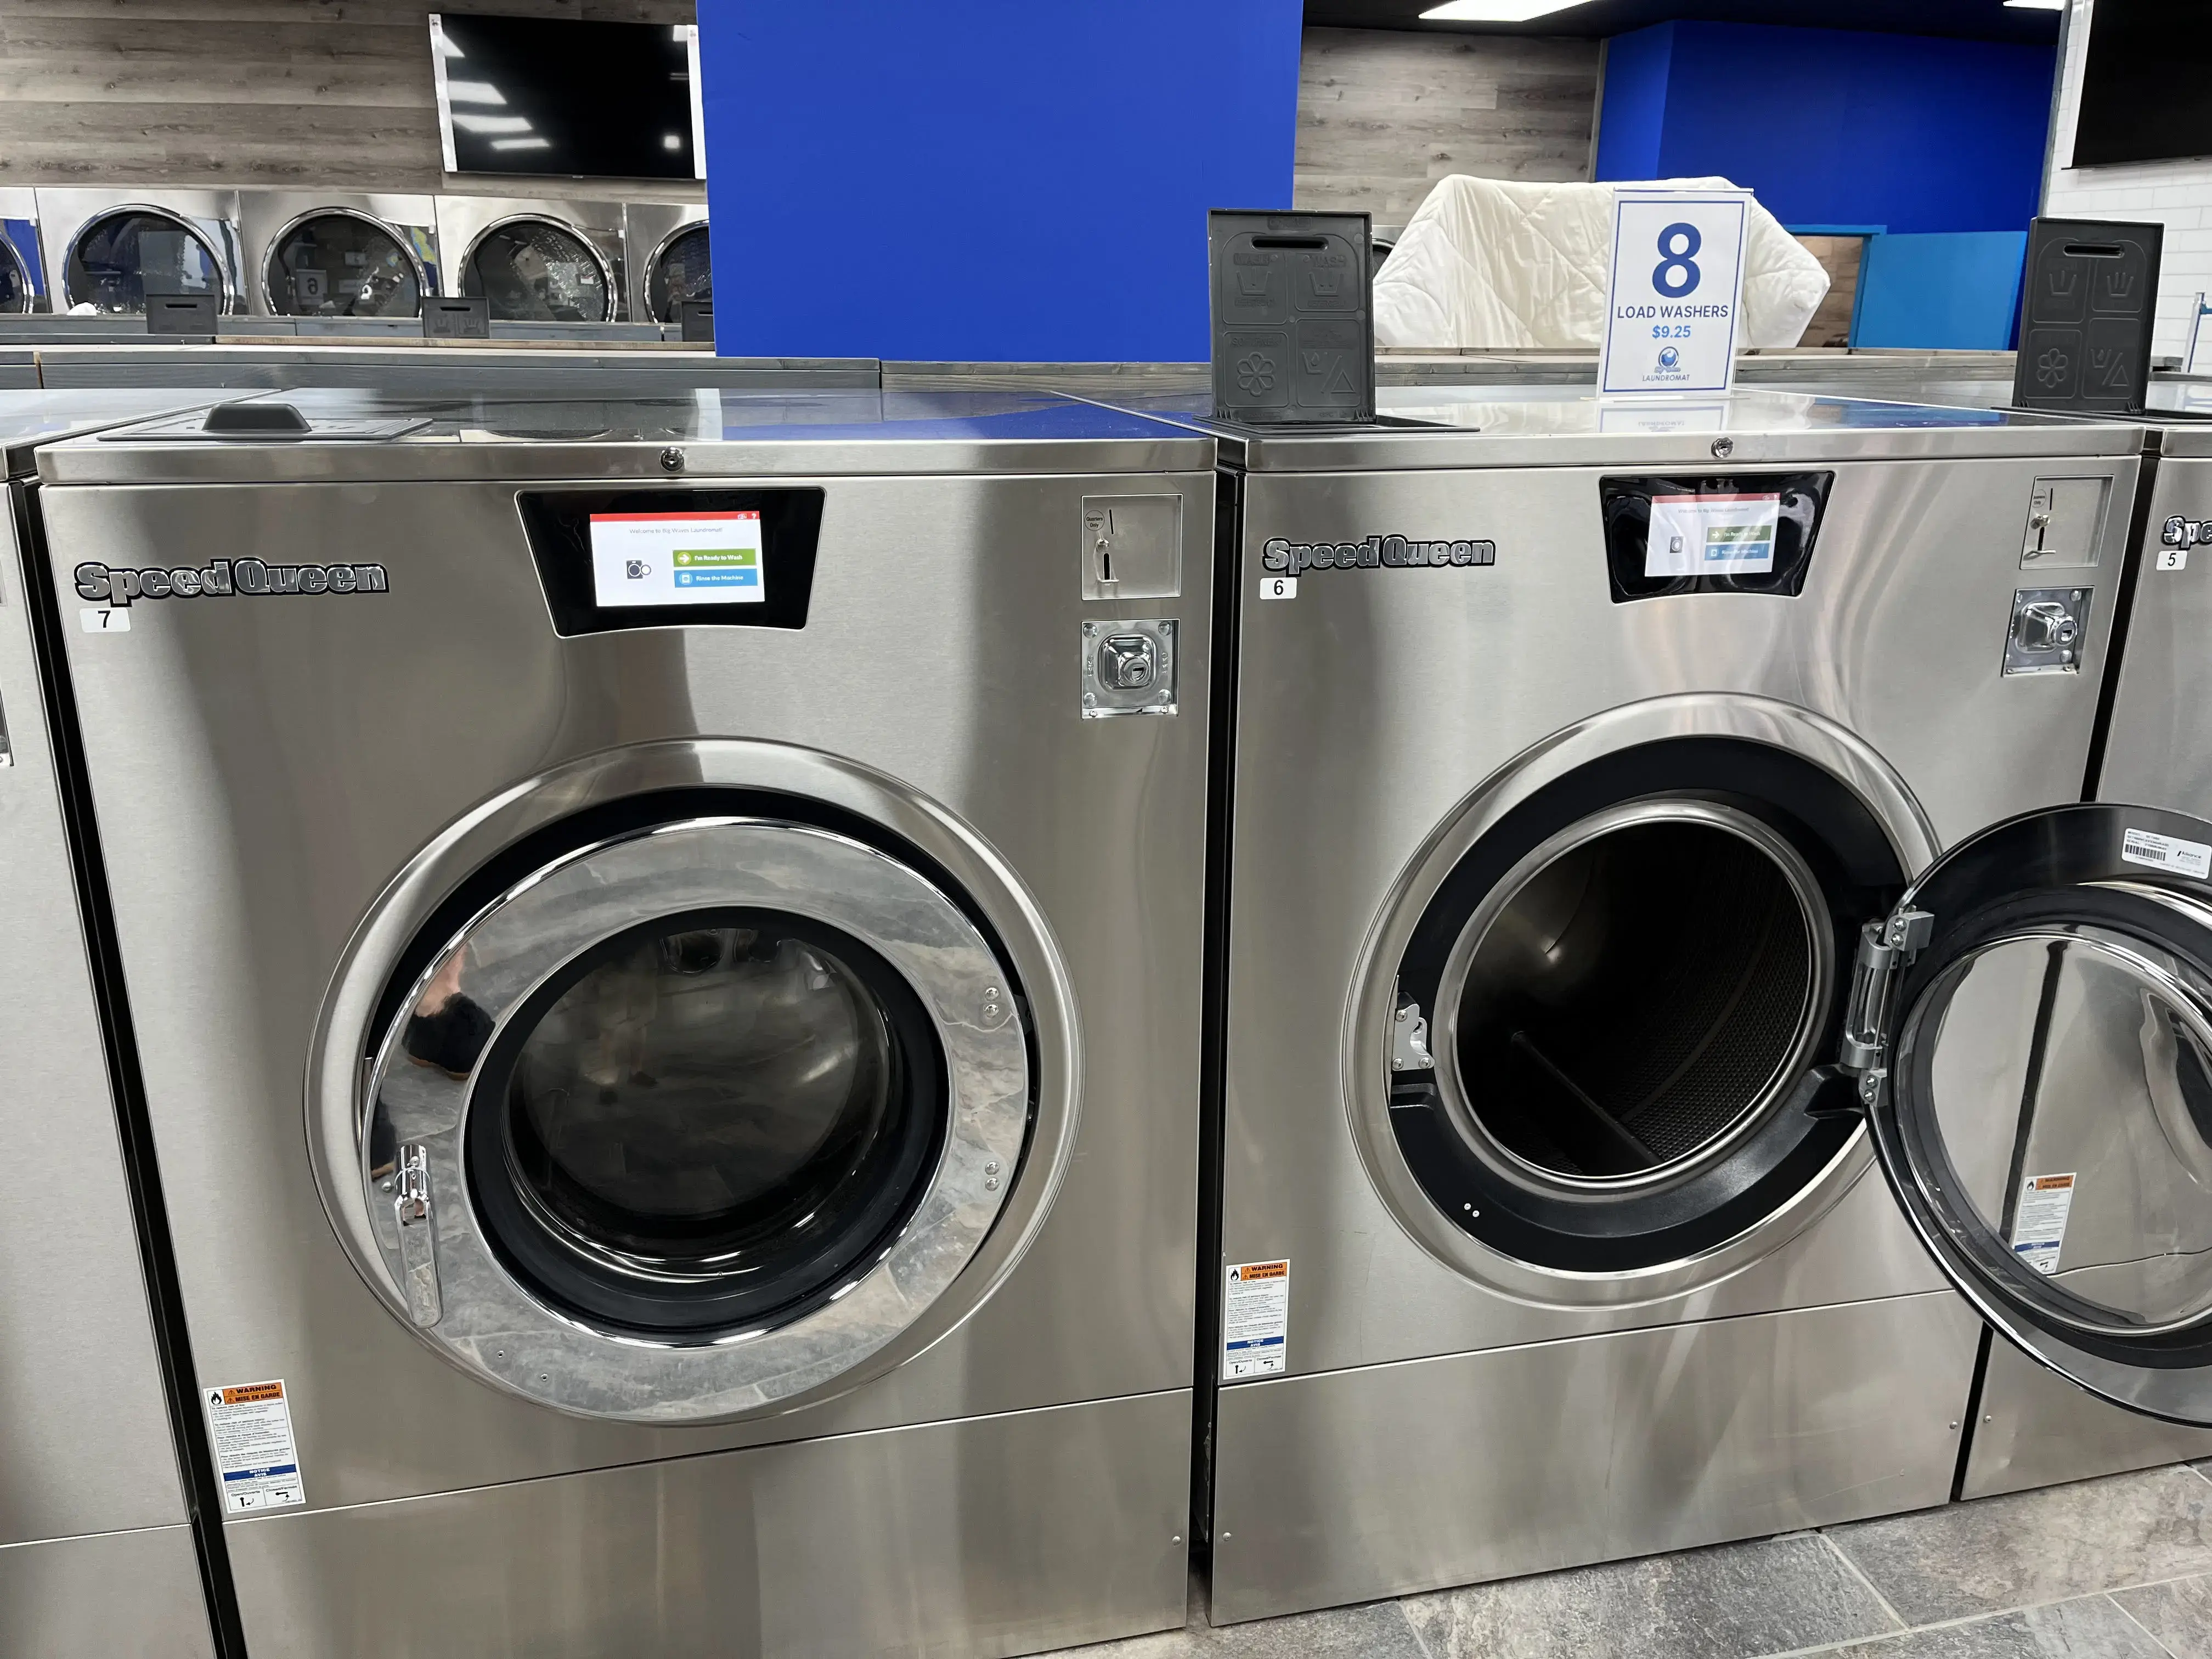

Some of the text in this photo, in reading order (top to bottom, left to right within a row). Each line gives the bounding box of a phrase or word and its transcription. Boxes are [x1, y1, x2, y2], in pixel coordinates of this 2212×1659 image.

[1652, 222, 1701, 298] 8
[1617, 305, 1728, 319] LOAD WASHERS
[1652, 325, 1691, 339] $9.25
[1263, 534, 1496, 577] Speed Queen
[2168, 552, 2177, 566] 5
[74, 557, 390, 607] Speed Queen
[1273, 580, 1284, 595] 6
[97, 611, 110, 628] 7
[1251, 1263, 1283, 1272] WARNING
[236, 1384, 276, 1394] WARNING
